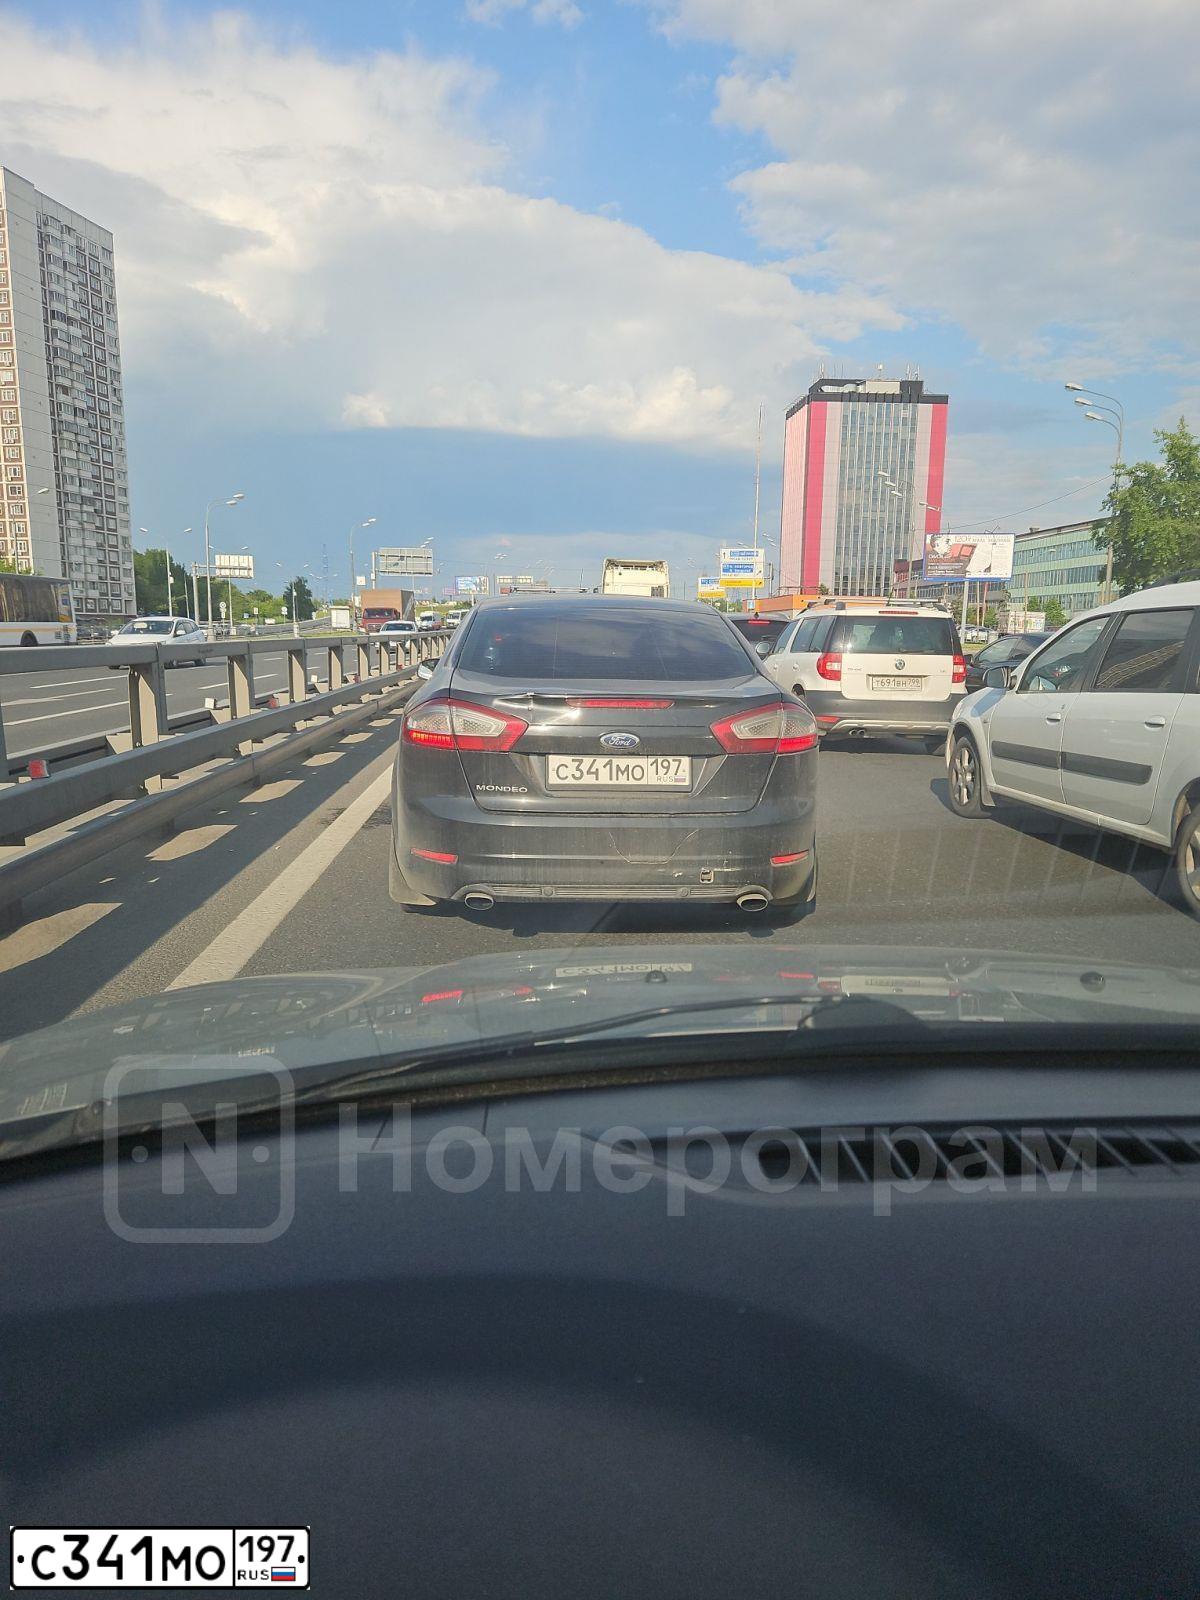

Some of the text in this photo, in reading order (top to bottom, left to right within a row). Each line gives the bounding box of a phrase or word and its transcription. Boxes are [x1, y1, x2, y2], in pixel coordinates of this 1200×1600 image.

[608, 735, 632, 746] Ford
[555, 758, 682, 782] С341МО 197
[476, 784, 528, 793] MONDEO
